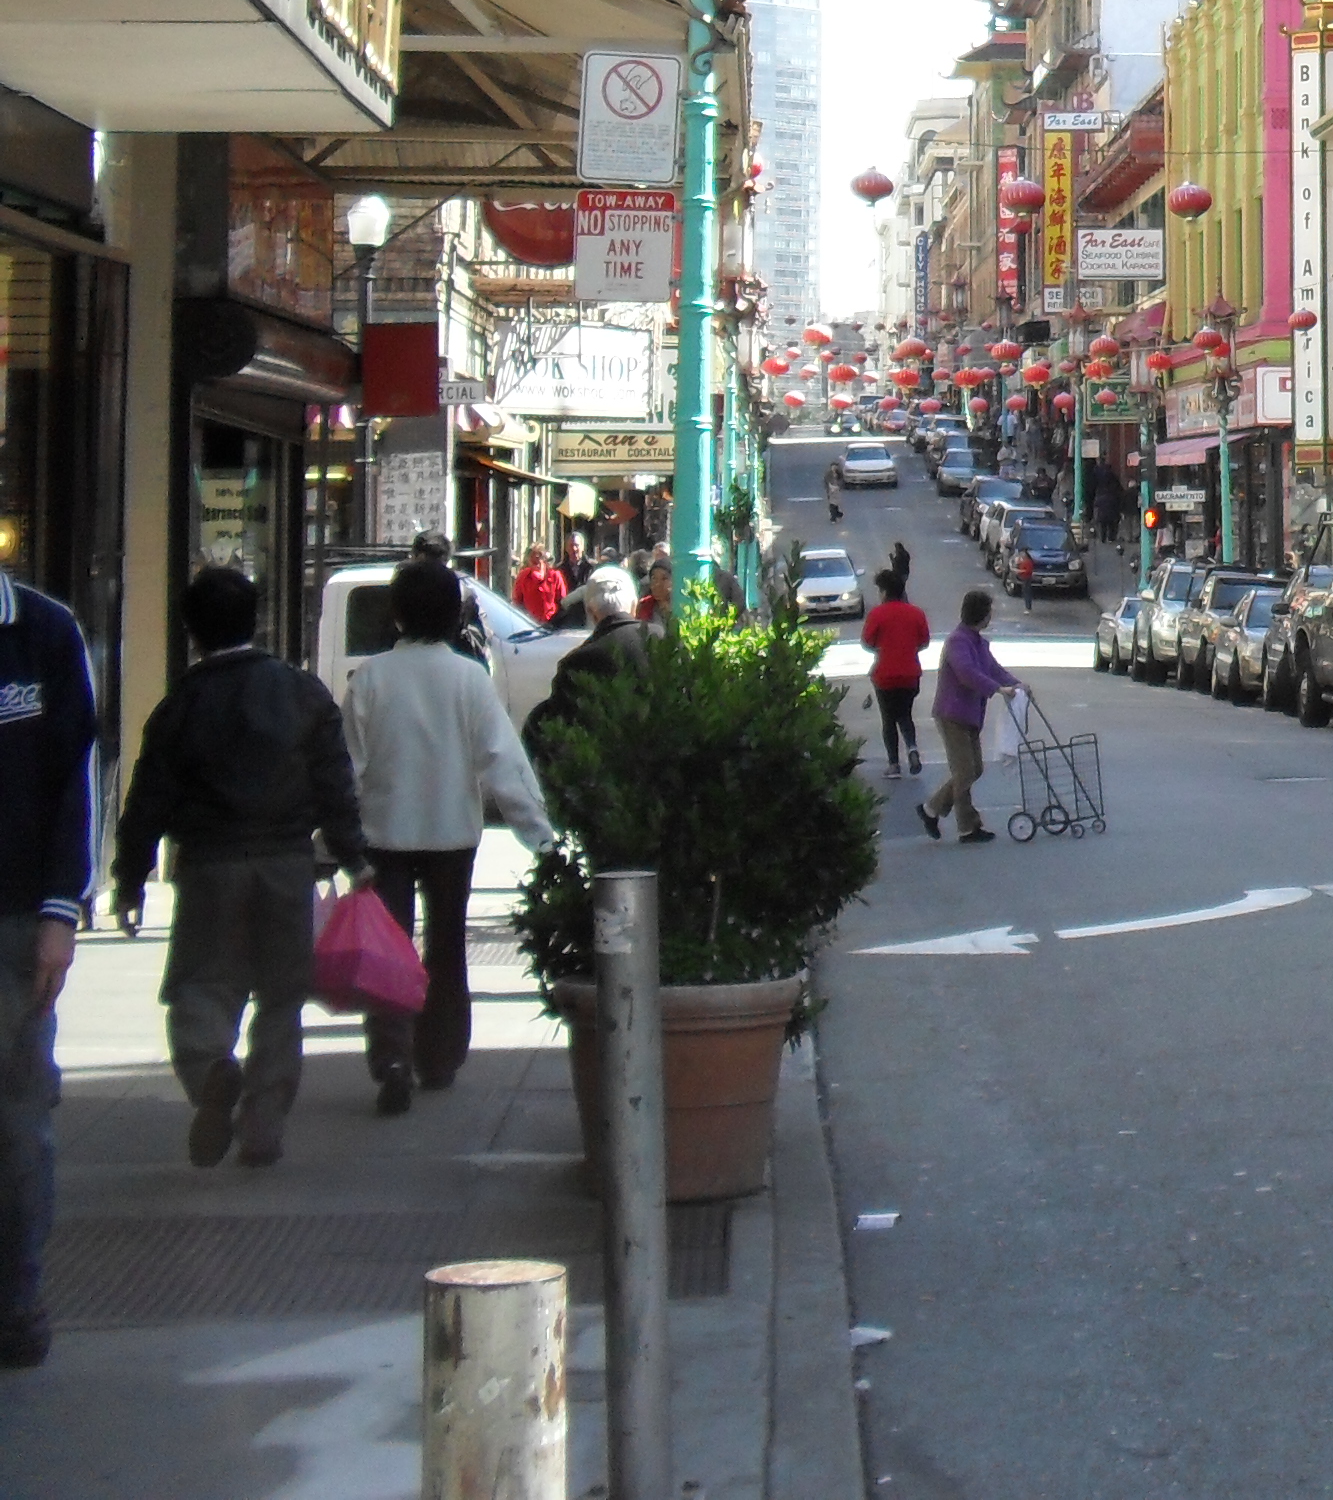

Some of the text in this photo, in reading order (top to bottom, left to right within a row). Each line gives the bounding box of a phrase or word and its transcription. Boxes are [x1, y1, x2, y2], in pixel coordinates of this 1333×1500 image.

[1047, 114, 1099, 127] Far East
[587, 194, 665, 209] TOW-AWAY
[578, 211, 670, 234] NO STOPPING
[606, 239, 643, 256] ANY
[1081, 232, 1107, 249] Far
[1109, 232, 1145, 249] East
[1300, 65, 1314, 428] Bank of Amrica
[604, 261, 644, 280] TIME
[577, 354, 640, 383] SHOP
[439, 386, 477, 400] RCIAL
[559, 448, 617, 458] RESTAURANT
[1156, 492, 1204, 501] SACRAMENTO
